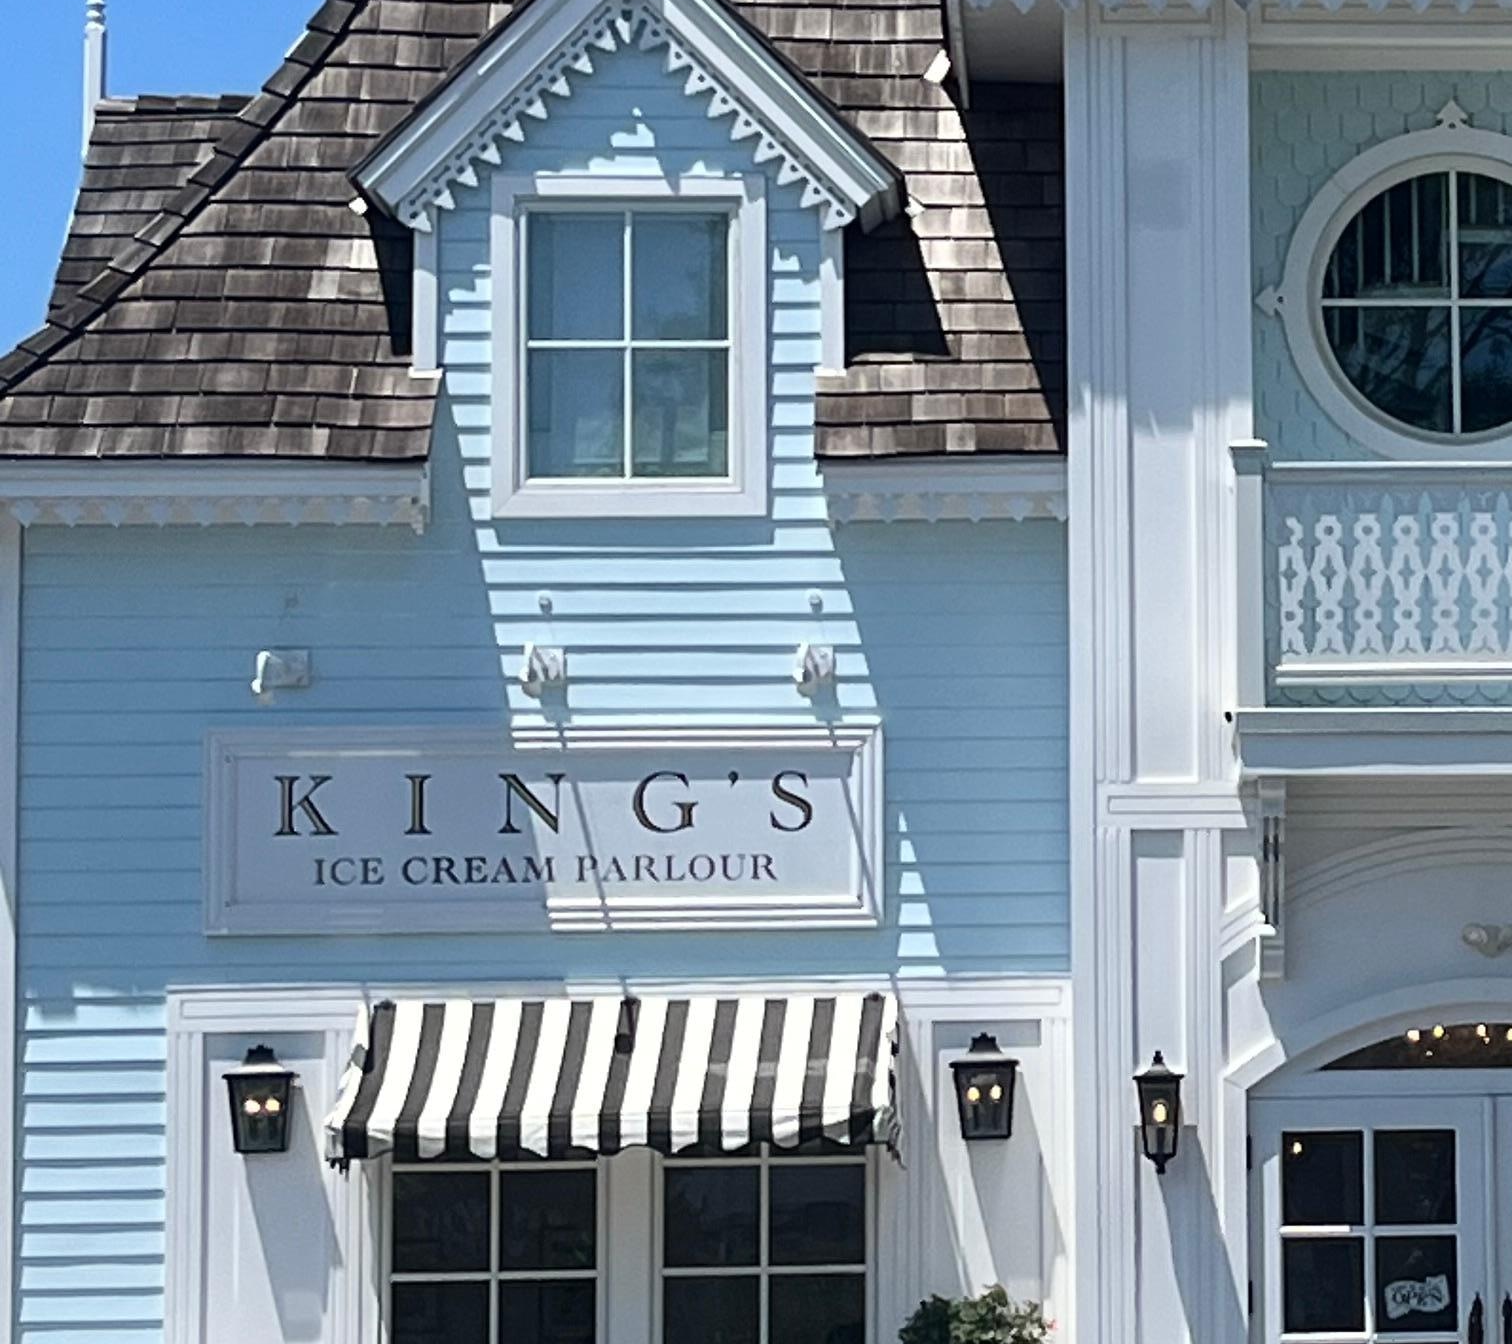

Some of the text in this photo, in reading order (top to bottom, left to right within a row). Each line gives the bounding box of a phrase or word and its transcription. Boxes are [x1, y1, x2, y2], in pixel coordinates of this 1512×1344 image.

[273, 770, 814, 837] KING'S
[314, 852, 778, 888] ICE CREAM PARLOUR
